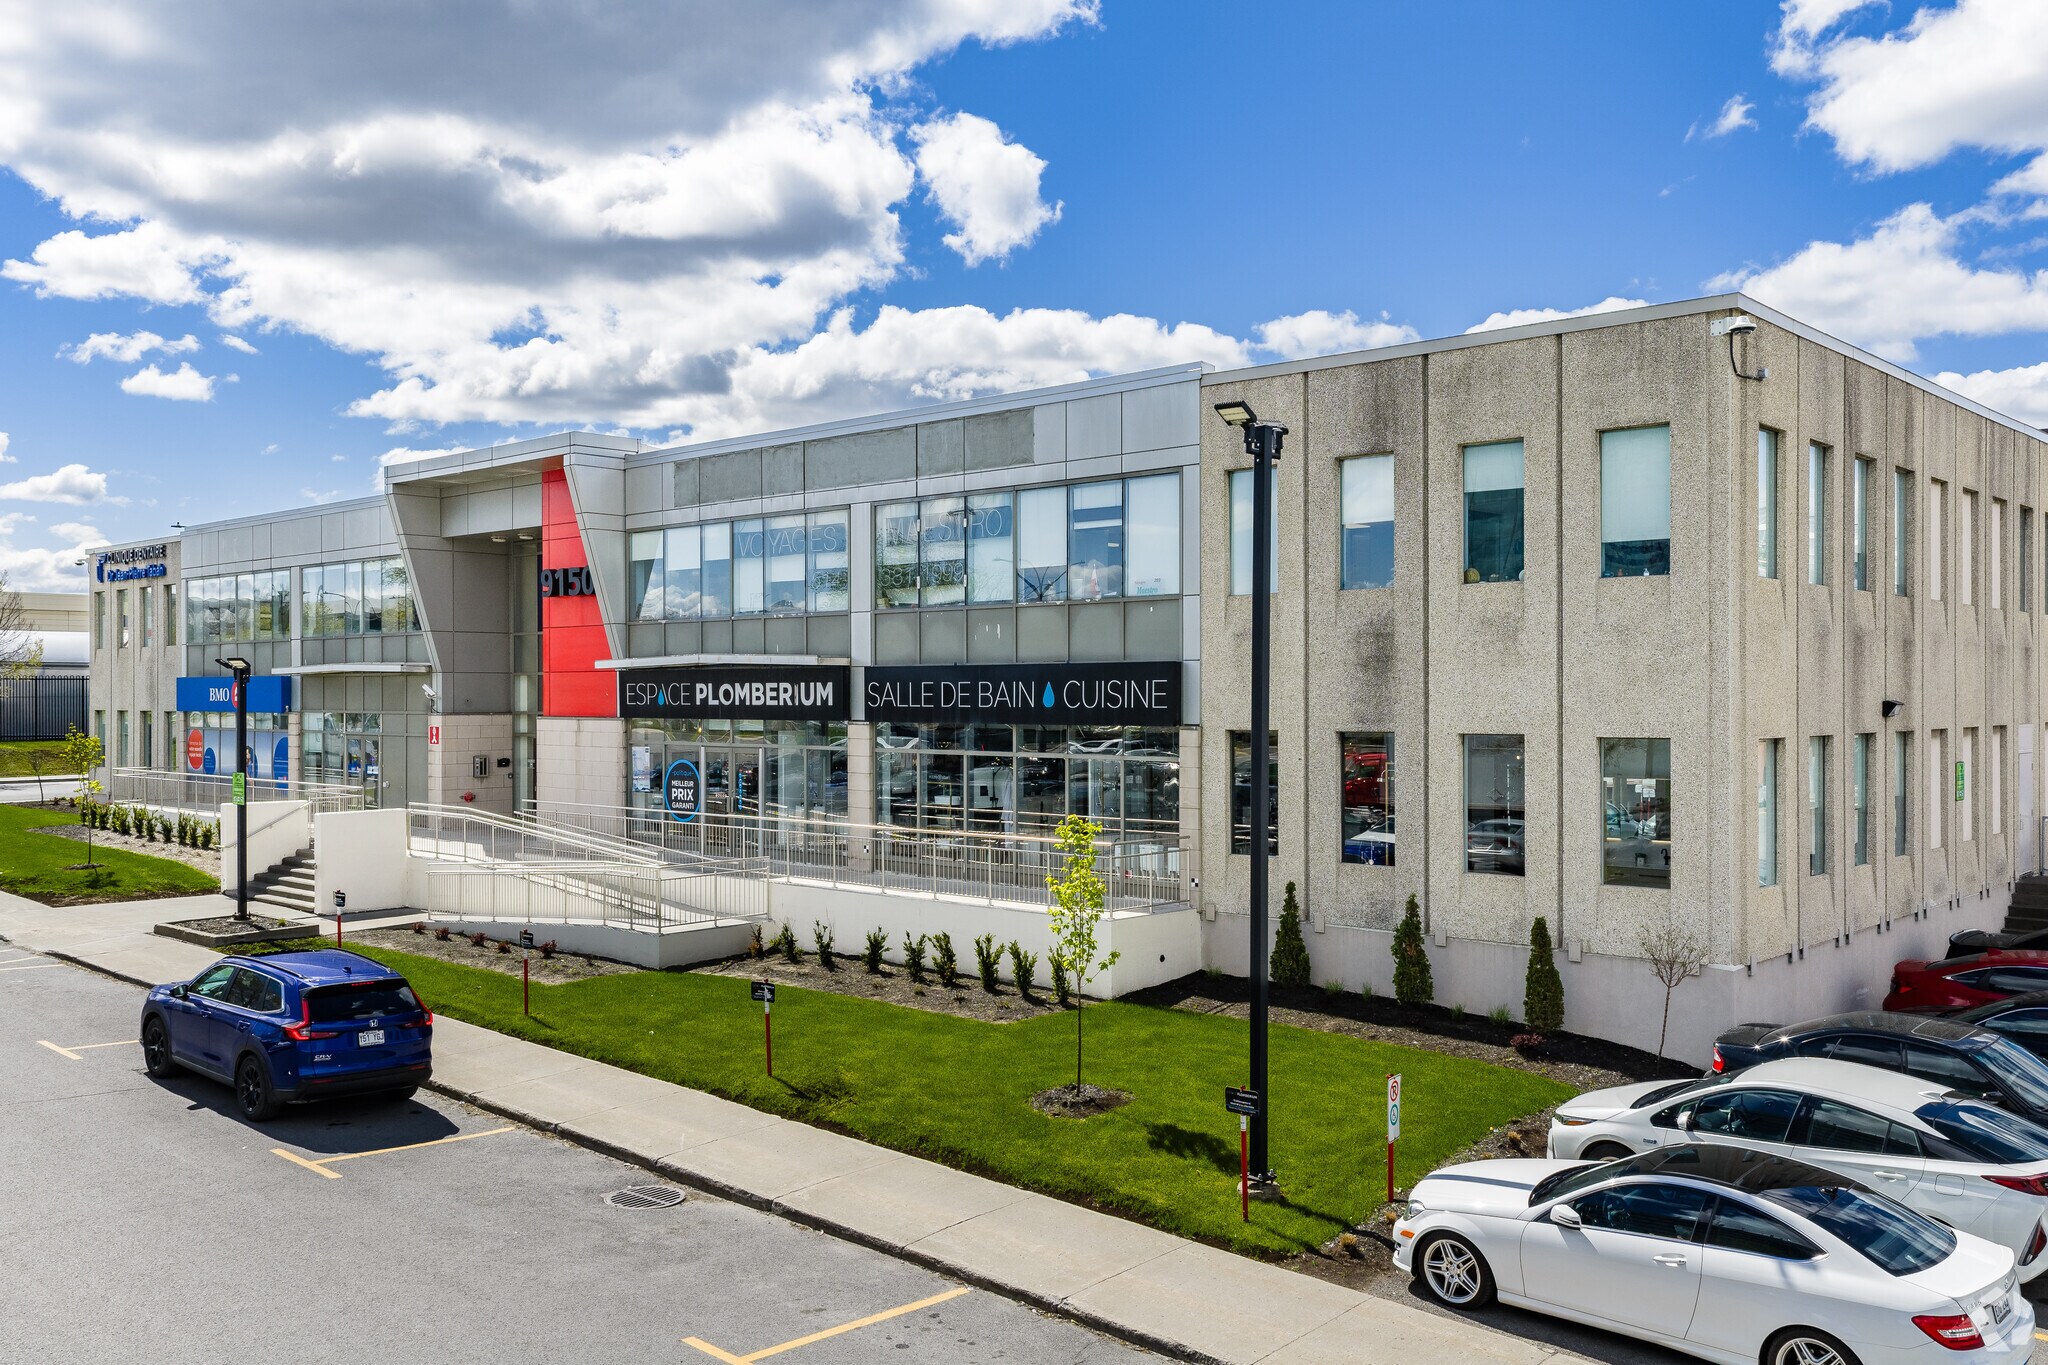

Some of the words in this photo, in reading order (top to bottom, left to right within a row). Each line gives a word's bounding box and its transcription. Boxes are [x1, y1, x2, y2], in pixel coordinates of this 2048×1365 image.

[738, 526, 838, 557] VOYAGES
[886, 508, 1002, 543] MAESTRO
[541, 566, 594, 597] 9150
[209, 687, 230, 702] BMO
[626, 683, 691, 706] ESPACE
[695, 682, 833, 706] PLOMBERIUM
[868, 681, 934, 708] SALLE
[941, 681, 971, 708] DE
[978, 681, 1035, 708] BAIN
[1063, 679, 1168, 709] CUISINE
[671, 780, 694, 788] MEILLEUR
[671, 788, 694, 801] PRIX
[671, 801, 694, 809] GARANTI
